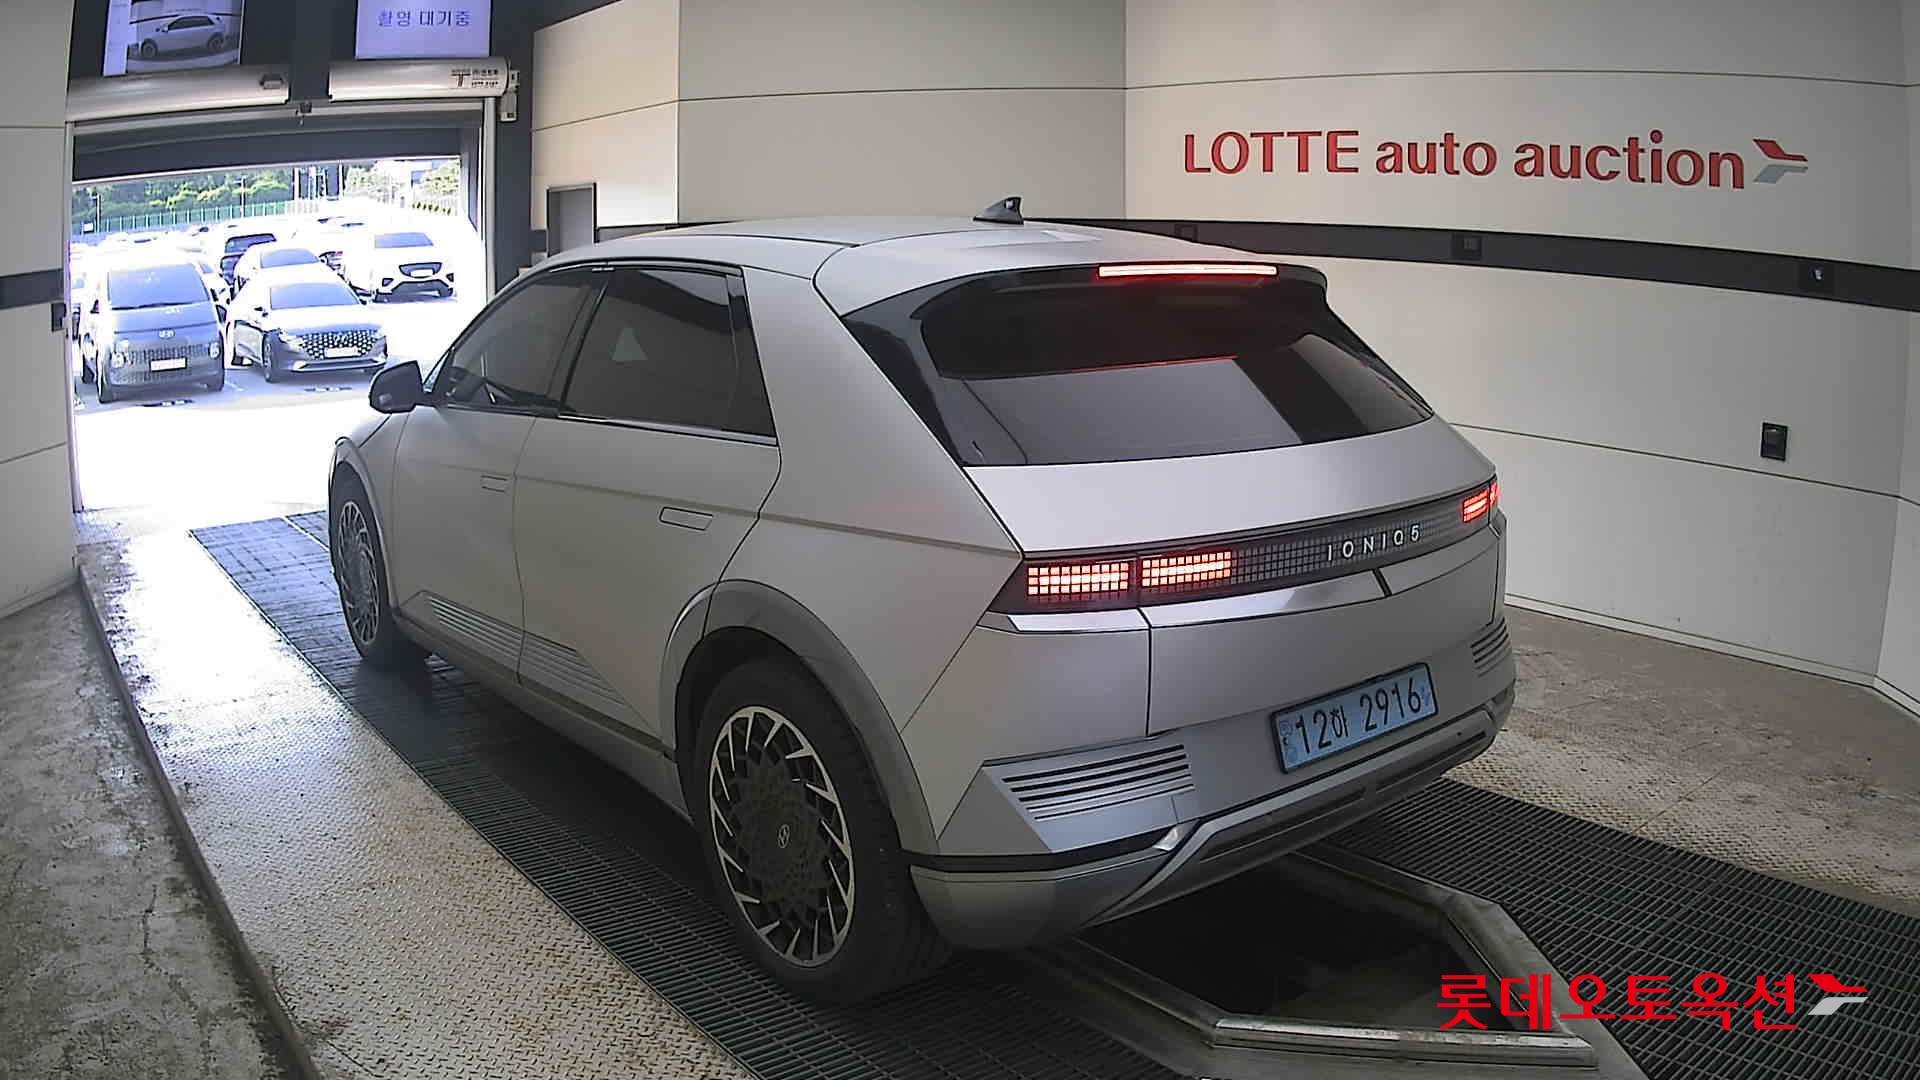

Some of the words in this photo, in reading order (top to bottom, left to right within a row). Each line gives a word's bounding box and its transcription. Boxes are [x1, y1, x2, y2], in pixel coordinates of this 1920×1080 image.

[419, 10, 471, 27] 대기중
[1184, 130, 1360, 174] LOTTE
[1375, 132, 1498, 177] auto
[1514, 129, 1745, 189] auction
[1295, 704, 1349, 754] 12하
[1359, 677, 1422, 732] 2916
